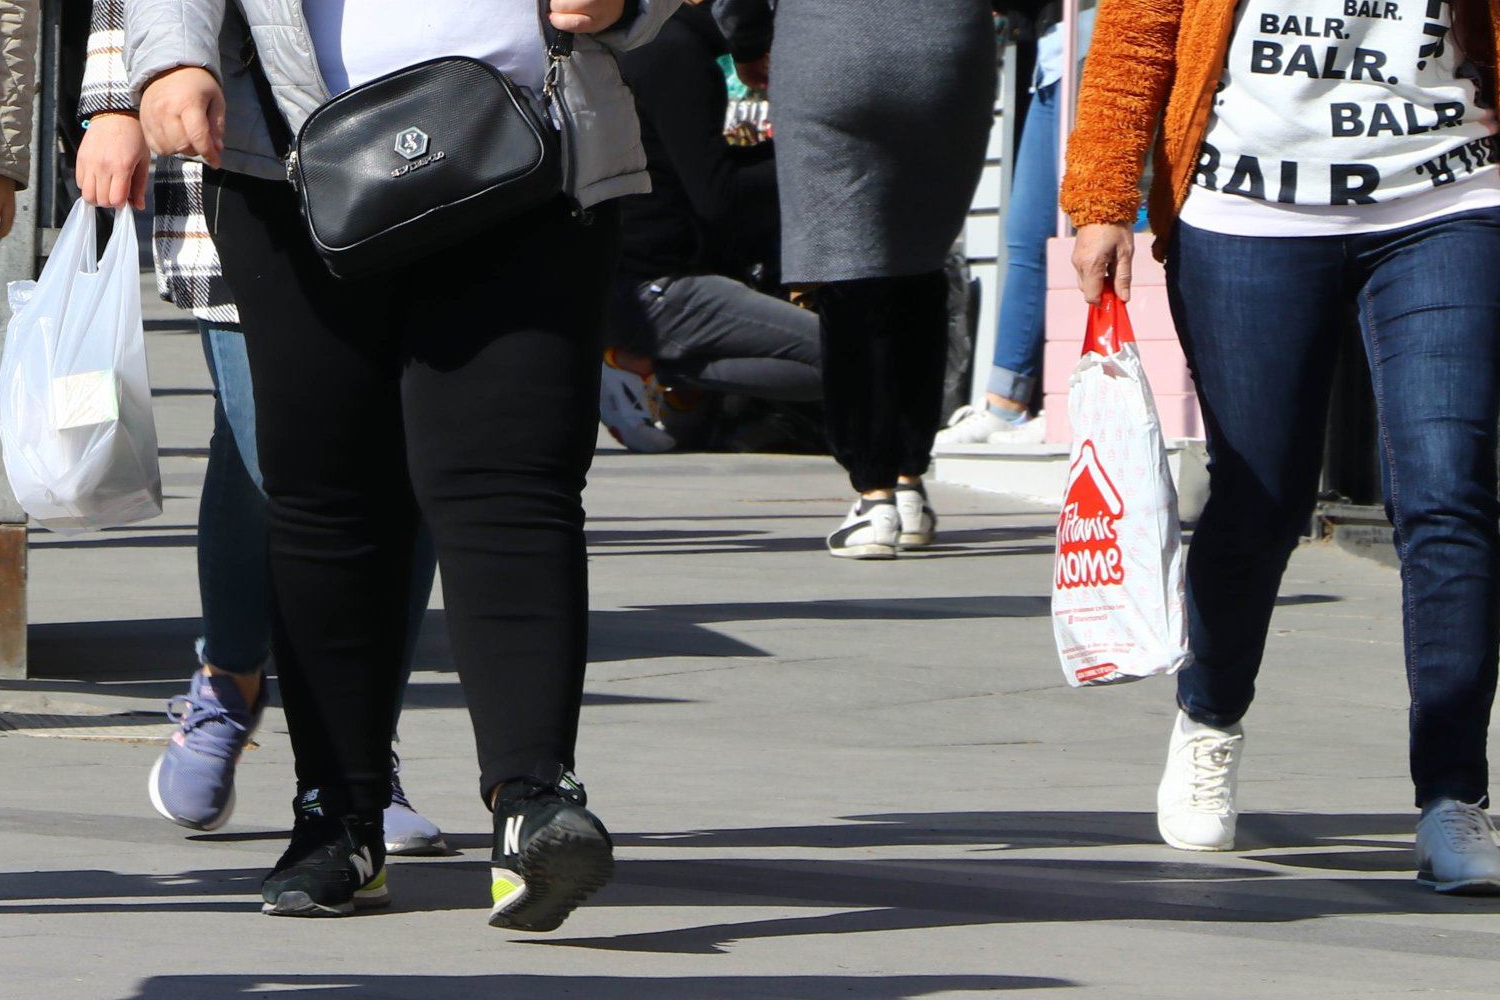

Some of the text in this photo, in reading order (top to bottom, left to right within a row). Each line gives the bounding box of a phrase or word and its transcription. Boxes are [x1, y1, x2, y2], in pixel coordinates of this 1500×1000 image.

[1260, 13, 1350, 39] BALR.
[1250, 40, 1398, 85] BALR.
[1062, 502, 1116, 545] Titanic
